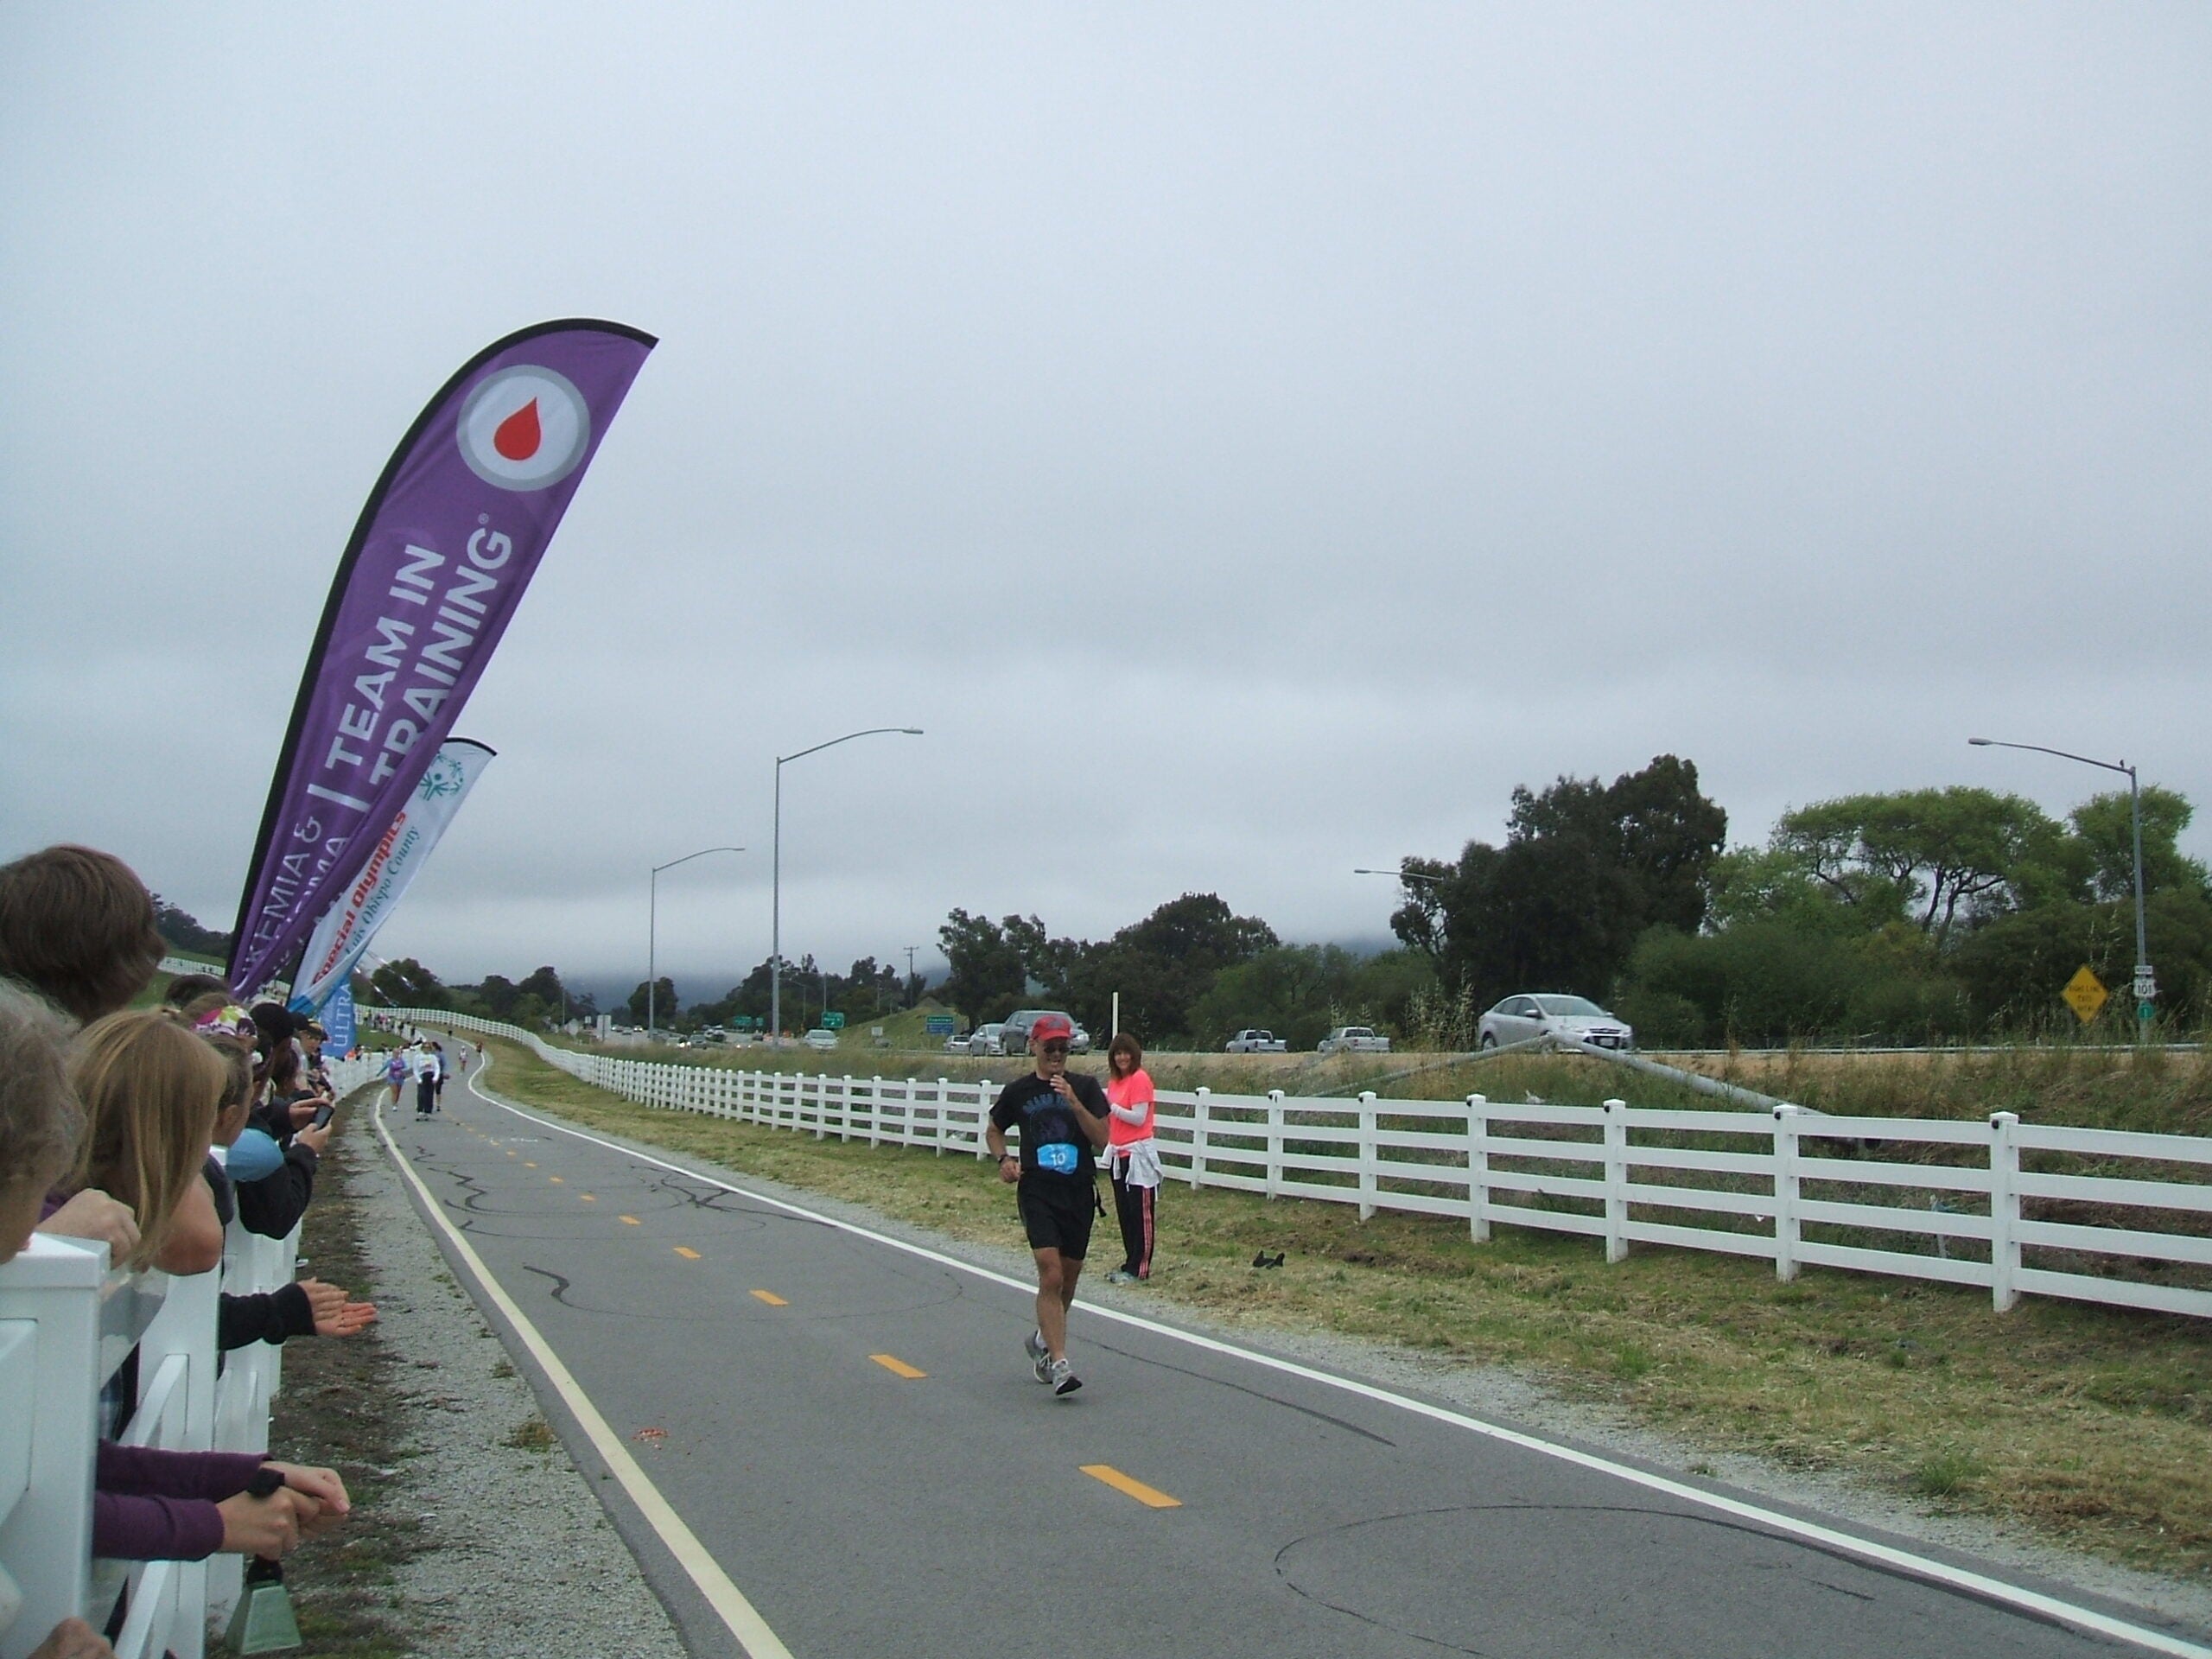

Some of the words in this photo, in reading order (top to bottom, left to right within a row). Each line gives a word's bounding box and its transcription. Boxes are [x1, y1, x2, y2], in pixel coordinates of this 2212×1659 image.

[325, 620, 415, 770] TEAM
[389, 544, 446, 606] IN
[369, 526, 513, 786] TRAINING
[293, 815, 322, 844] &
[352, 810, 407, 908] Olympics
[361, 878, 391, 924] Obispo
[386, 825, 421, 875] County
[334, 983, 351, 1047] ULTRA
[2138, 984, 2152, 995] 101
[1051, 1153, 1066, 1166] 10
